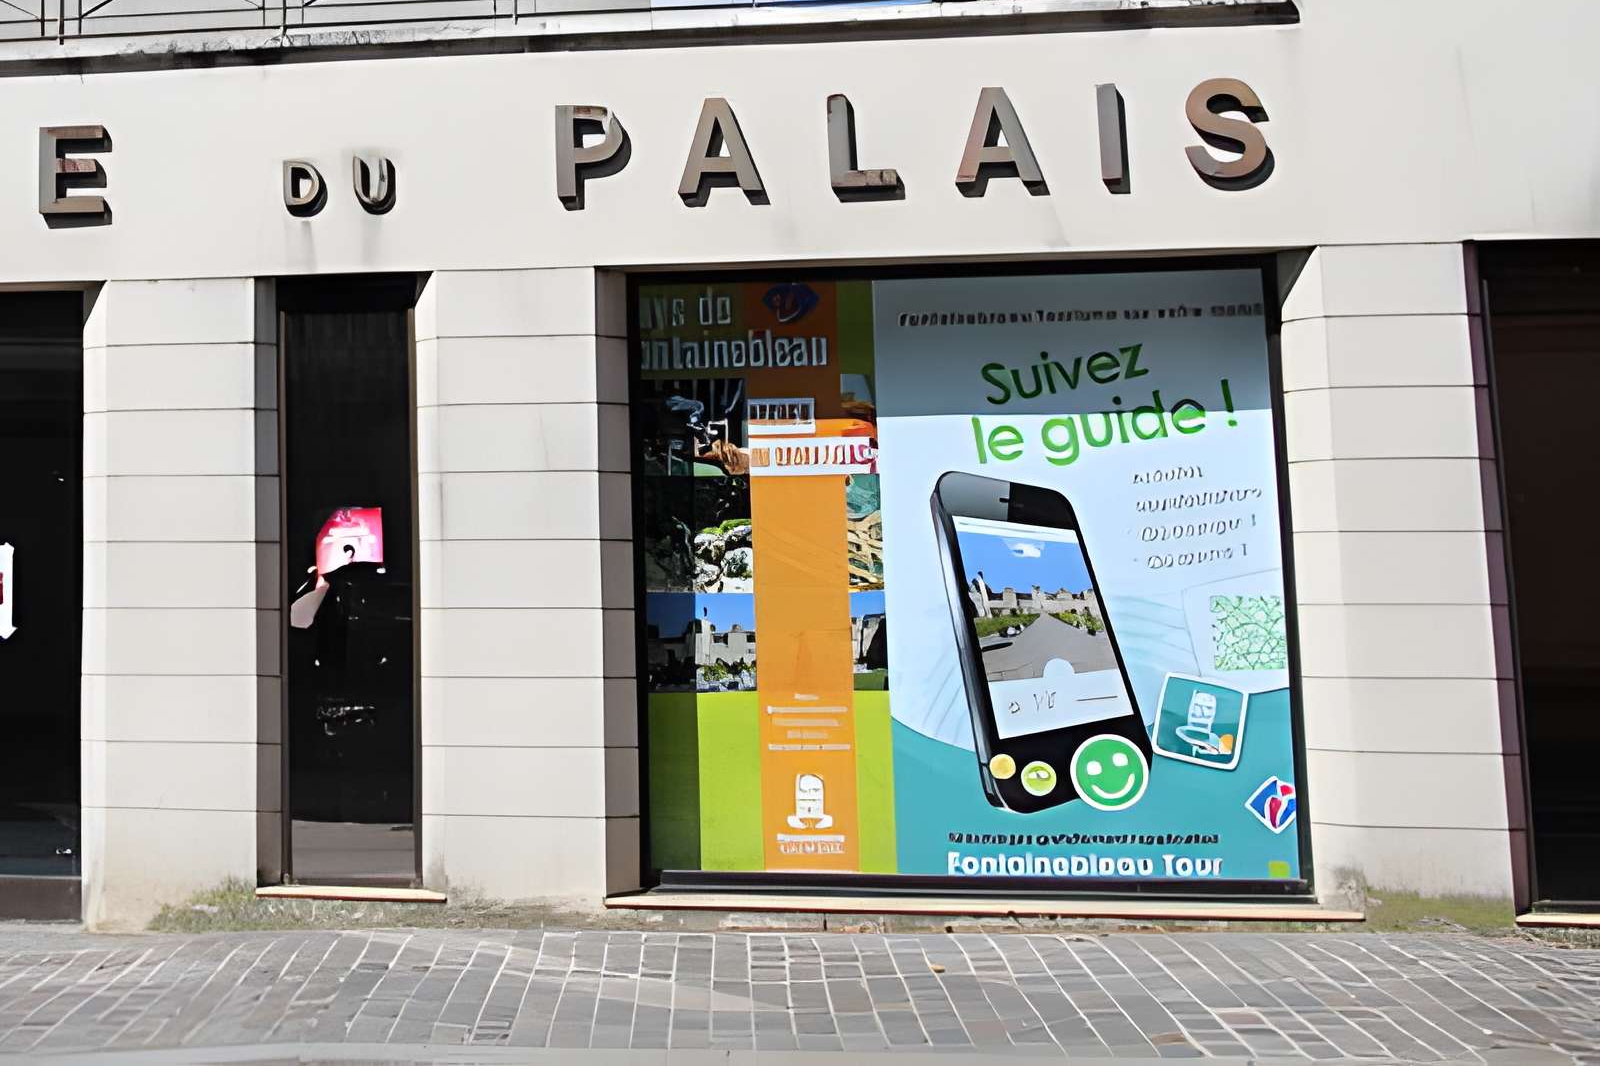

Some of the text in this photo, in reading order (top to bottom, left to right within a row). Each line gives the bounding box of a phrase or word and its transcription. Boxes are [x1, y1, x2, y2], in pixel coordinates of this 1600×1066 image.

[282, 154, 396, 218] DU
[555, 77, 1275, 211] PALAIS
[981, 343, 1149, 405] Suivez
[971, 415, 1024, 465] le
[1041, 390, 1206, 466] guide
[1162, 853, 1223, 877] Tour
